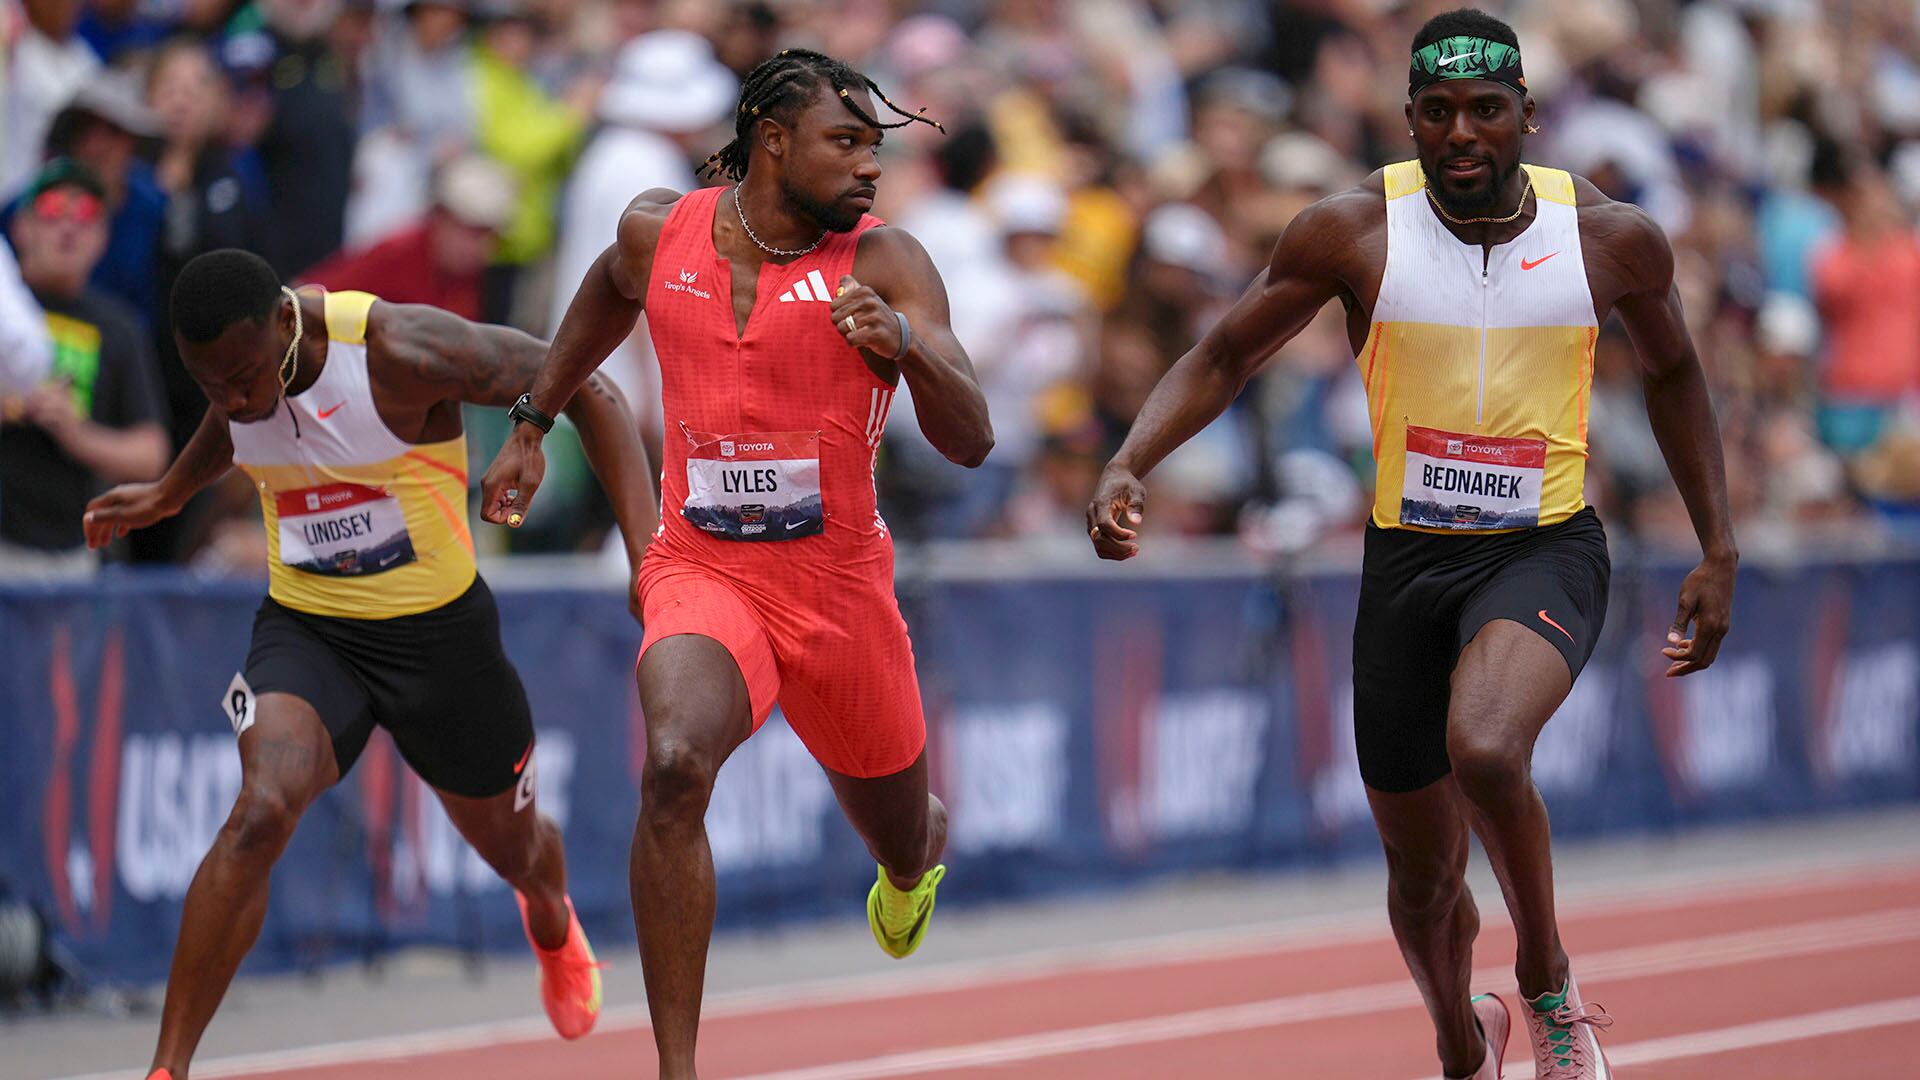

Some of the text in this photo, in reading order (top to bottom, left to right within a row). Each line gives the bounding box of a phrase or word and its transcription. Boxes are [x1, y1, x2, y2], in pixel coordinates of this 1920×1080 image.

[664, 281, 711, 299] Tirop's Angels
[737, 443, 775, 452] TOYOTA
[1464, 444, 1503, 456] TOYOTA
[722, 469, 778, 493] LYLES
[1422, 463, 1523, 499] BEDNAREK
[321, 490, 353, 504] TOYOTA
[303, 511, 373, 546] LINDSEY
